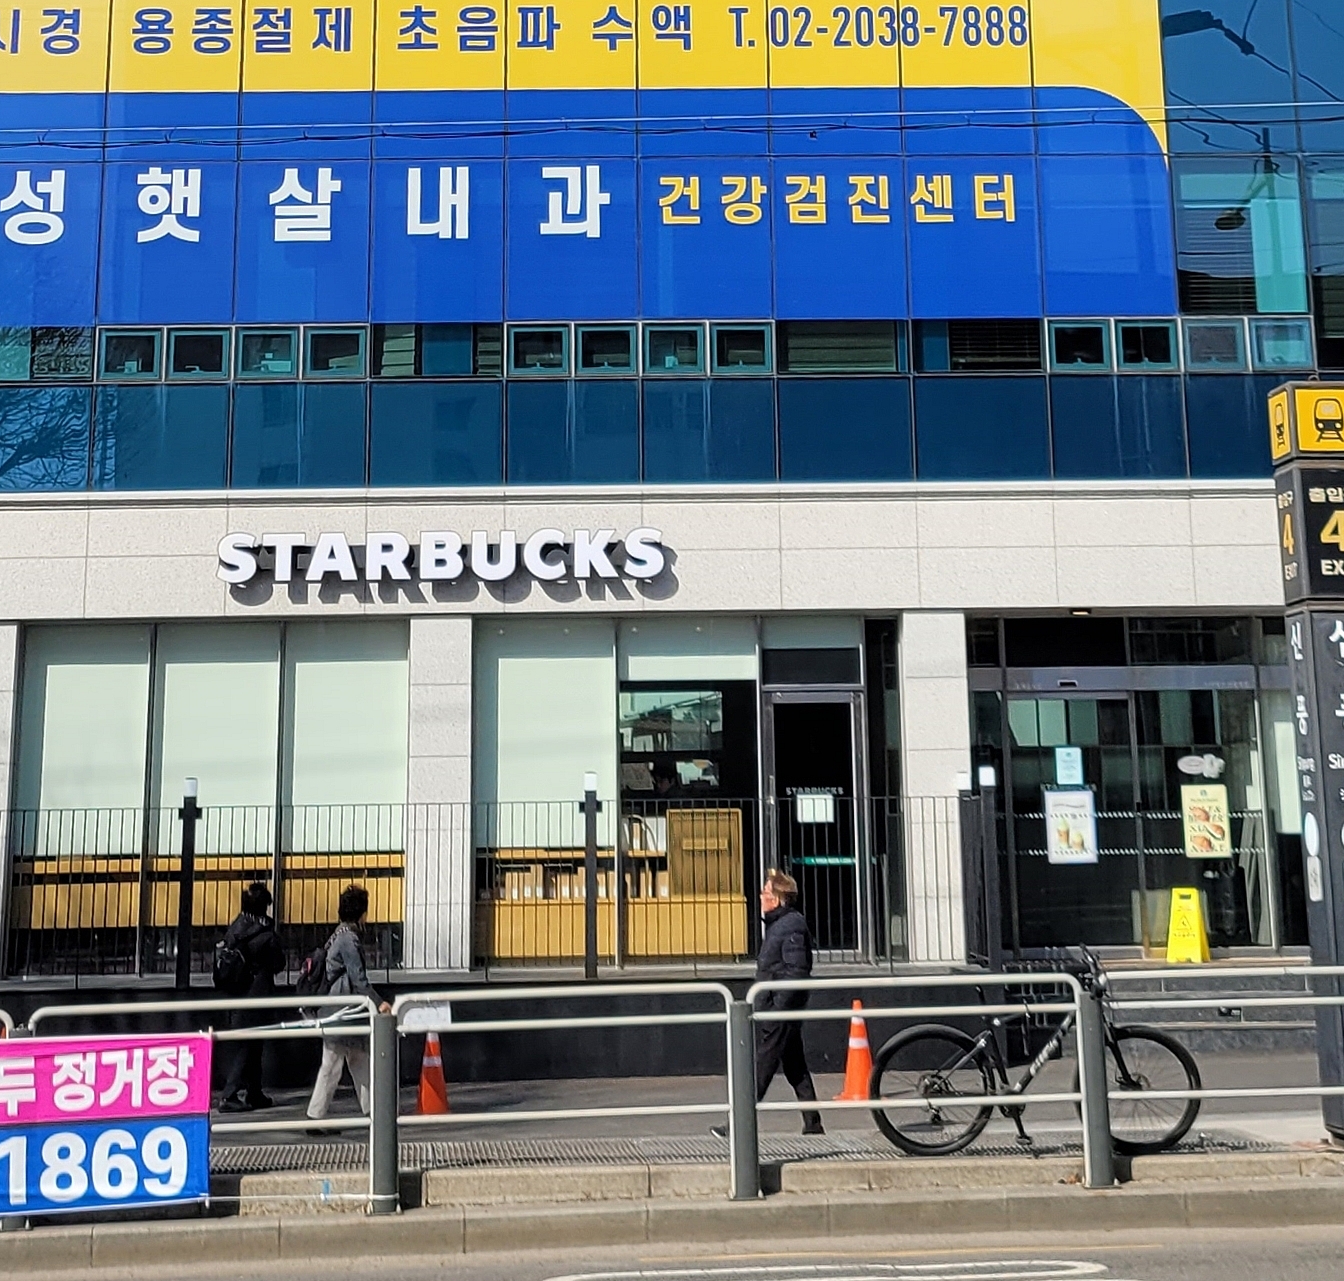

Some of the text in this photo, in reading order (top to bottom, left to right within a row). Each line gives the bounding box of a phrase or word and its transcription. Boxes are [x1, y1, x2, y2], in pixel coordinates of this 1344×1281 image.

[131, 6, 354, 53] 용종절제
[397, 5, 561, 50] 초음파
[592, 5, 694, 50] 수액
[658, 174, 1018, 224] 건강검진센터
[216, 527, 666, 584] STARBUCKS
[785, 786, 845, 796] STARBUCKS
[52, 1045, 195, 1111] 정거장
